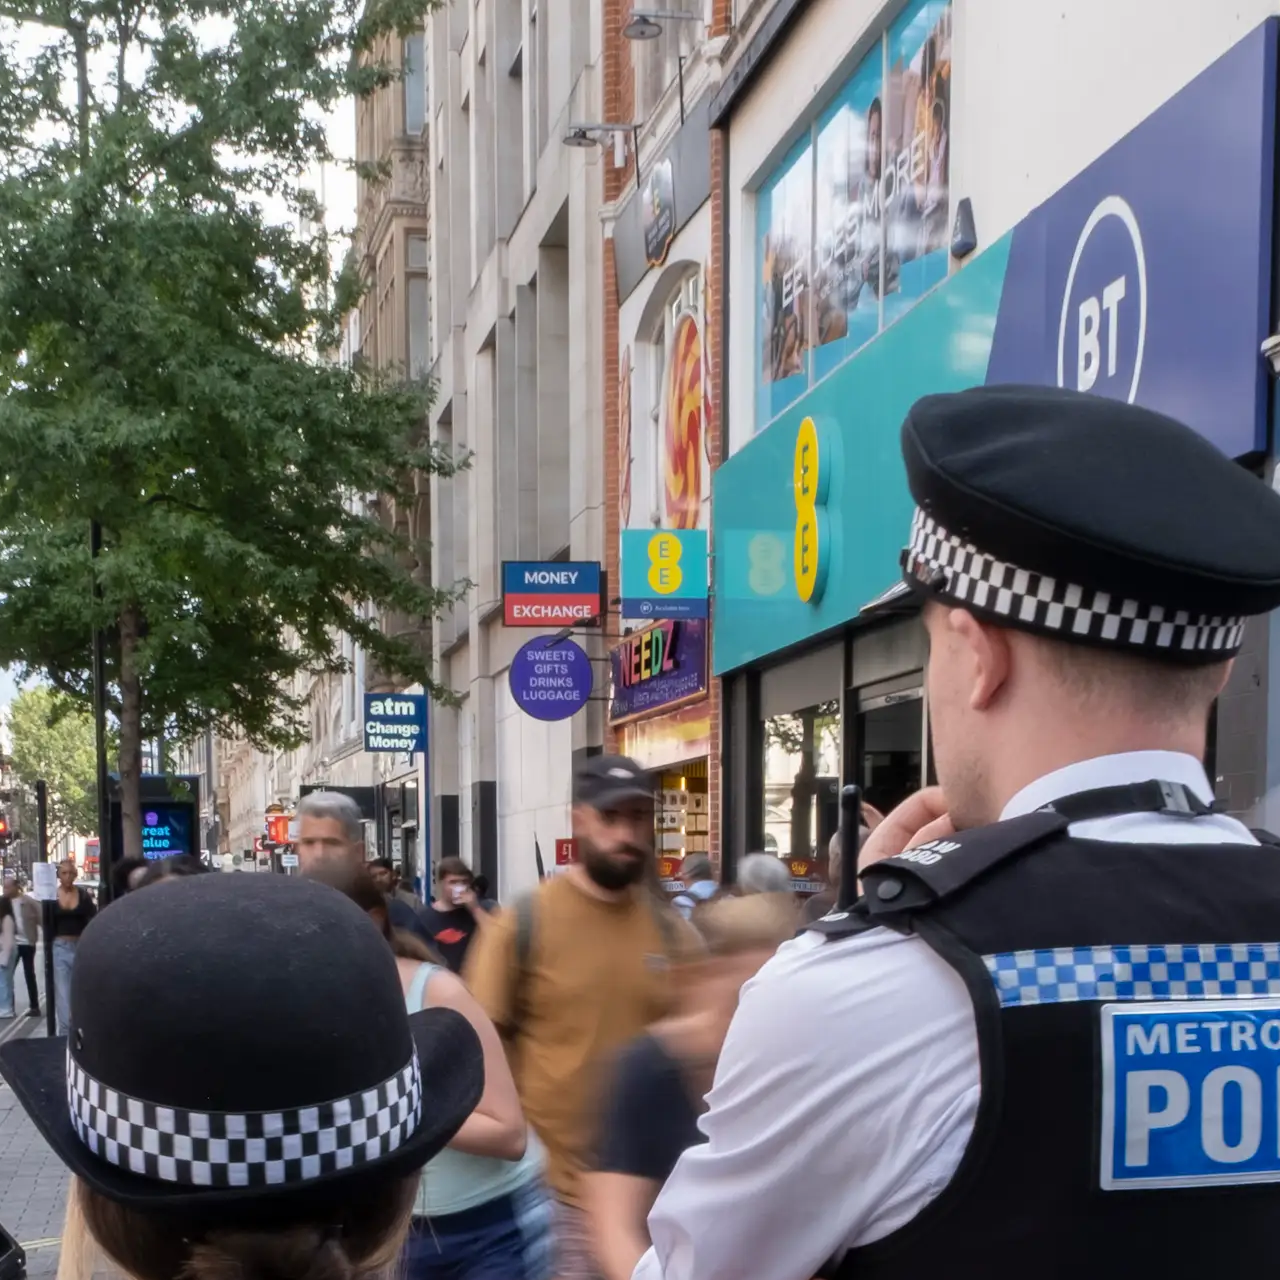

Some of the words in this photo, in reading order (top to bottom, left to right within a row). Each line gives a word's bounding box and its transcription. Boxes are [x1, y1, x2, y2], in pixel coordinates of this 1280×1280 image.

[1077, 275, 1126, 393] BT
[524, 571, 578, 585] MONEY
[513, 605, 591, 618] EXCHANGE
[526, 650, 575, 661] SWEETS
[620, 619, 674, 688] NEEDZ
[534, 664, 568, 674] GIFTS
[529, 677, 573, 688] DRINKS
[522, 690, 580, 700] LUGGAGE
[370, 697, 416, 716] atm
[365, 721, 420, 737] Change
[368, 735, 417, 751] Money
[141, 826, 171, 836] reat
[142, 837, 170, 848] alue
